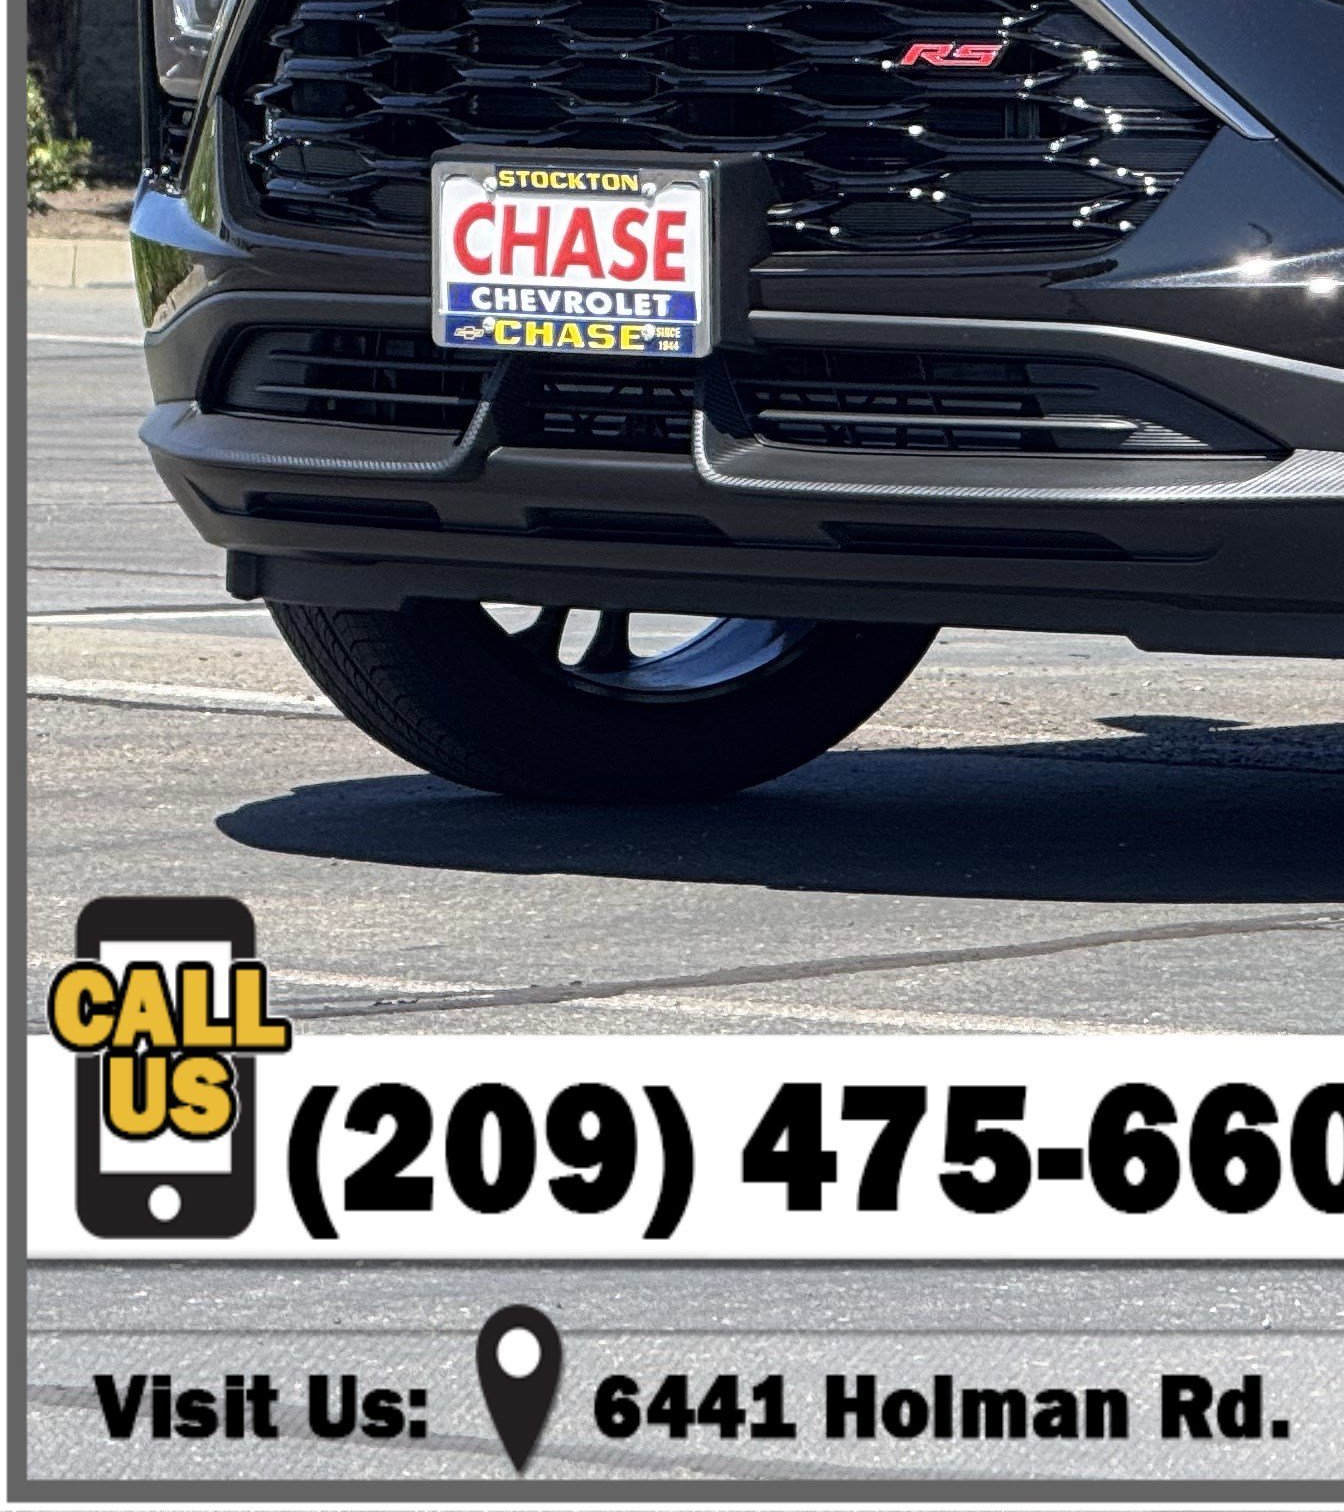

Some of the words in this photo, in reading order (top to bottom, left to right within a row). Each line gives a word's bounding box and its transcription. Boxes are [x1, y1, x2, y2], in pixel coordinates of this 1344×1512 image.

[900, 43, 1003, 67] RS
[498, 169, 639, 192] STOCKTON
[453, 201, 687, 283] CHASE
[471, 286, 671, 317] CHEVROLET
[494, 319, 646, 351] CHASE
